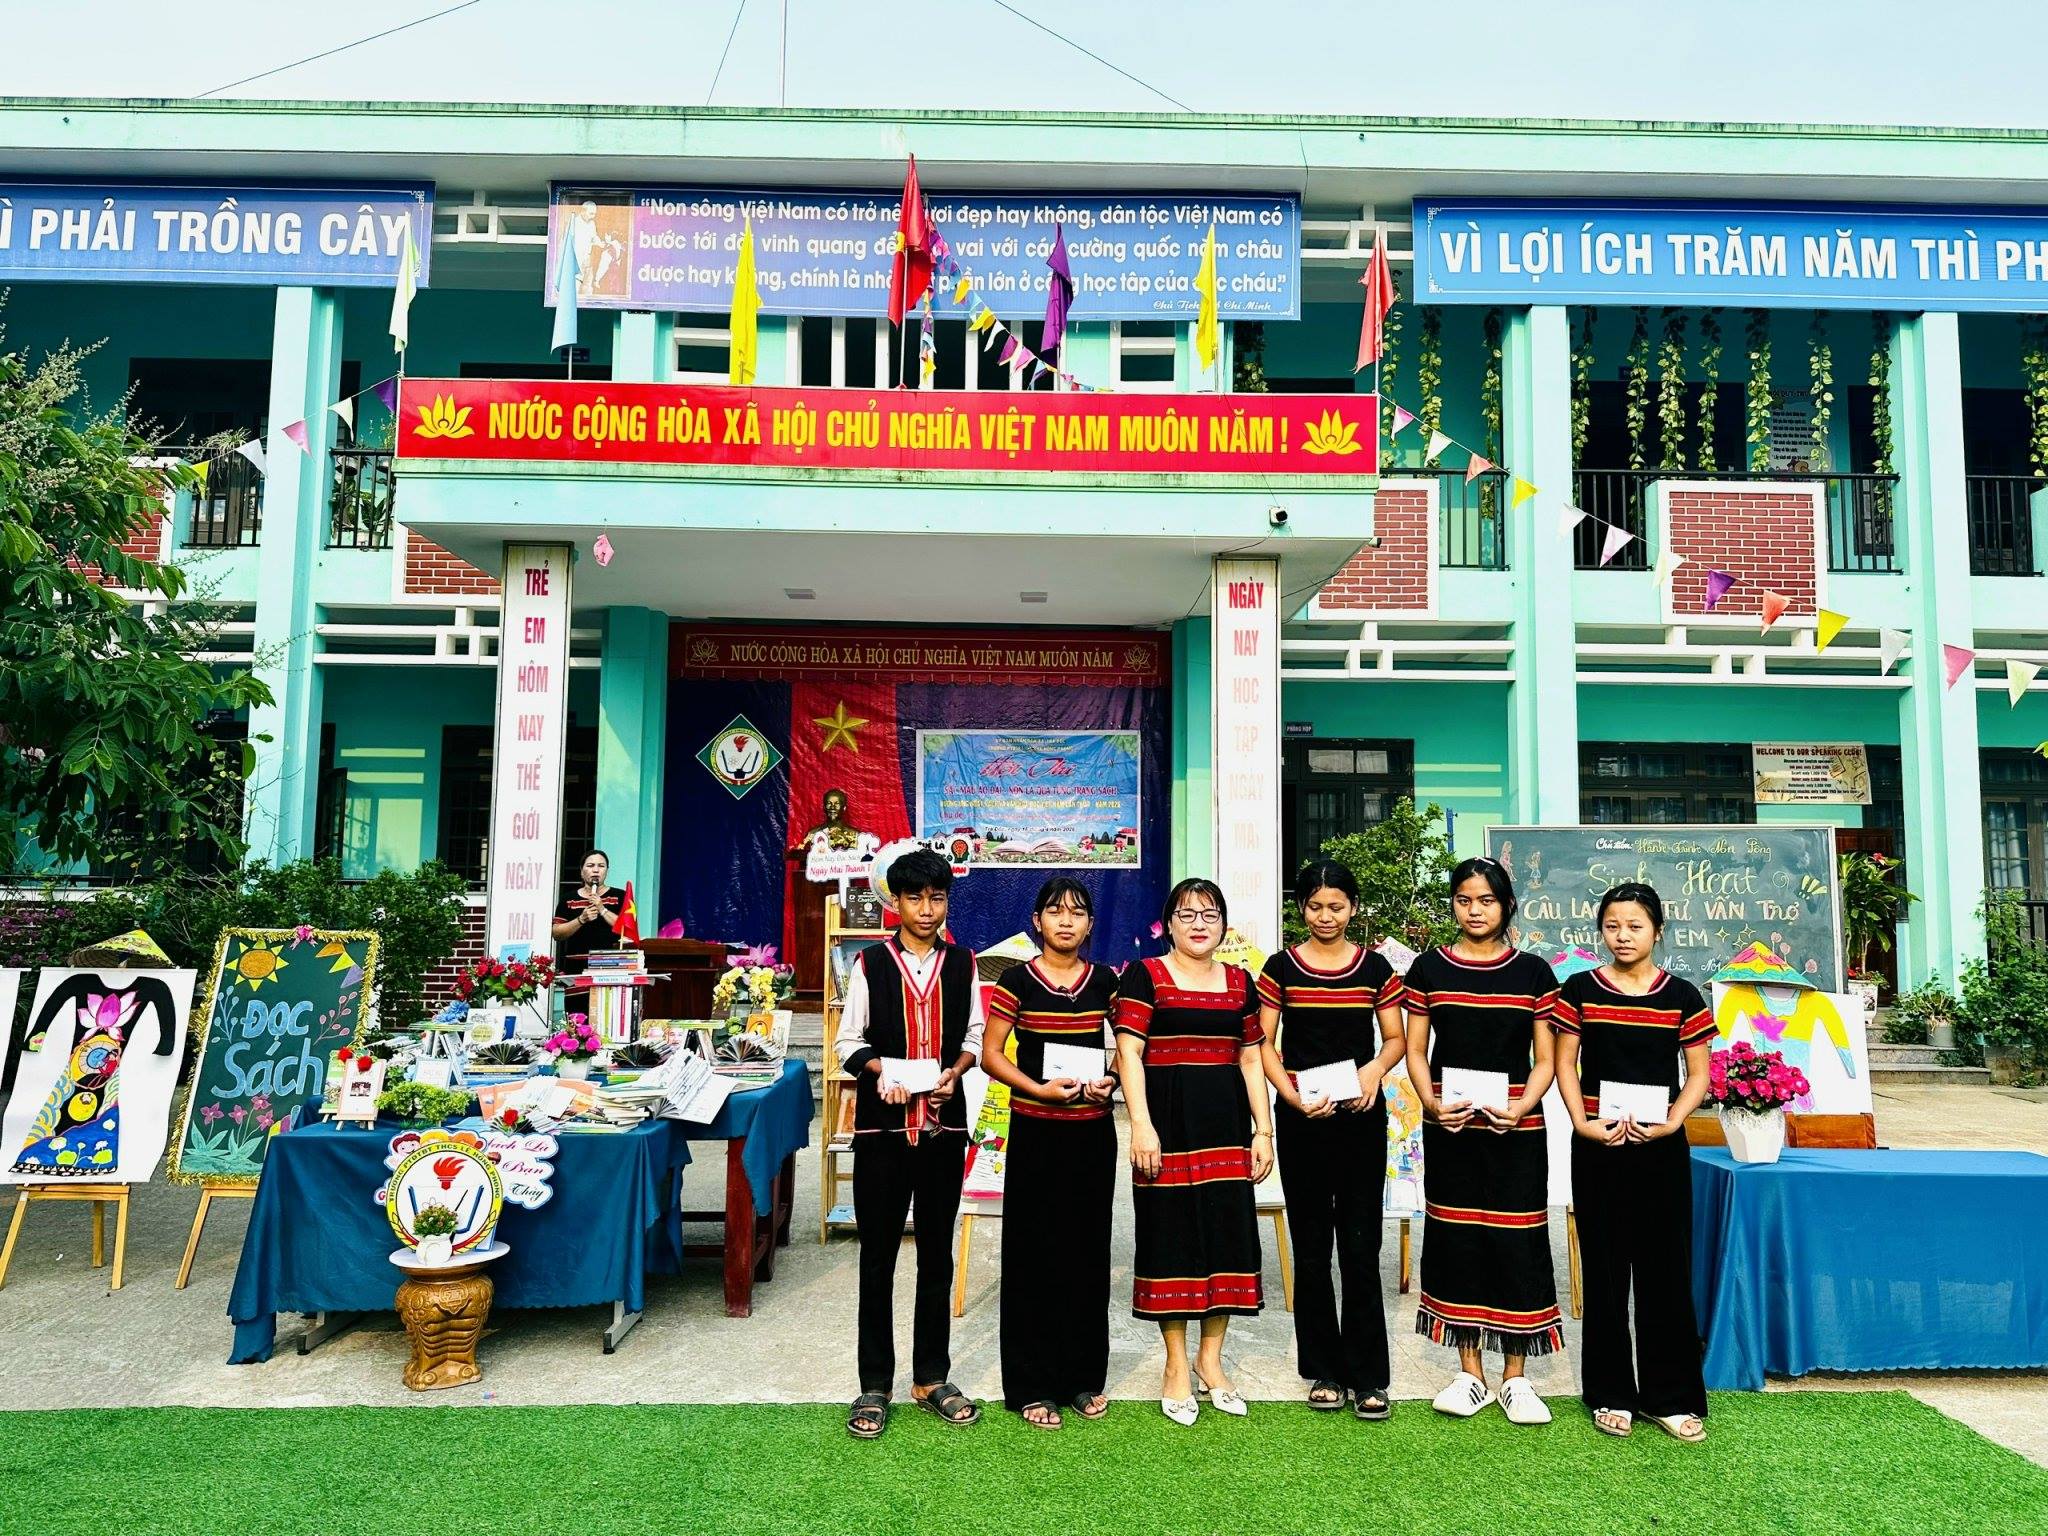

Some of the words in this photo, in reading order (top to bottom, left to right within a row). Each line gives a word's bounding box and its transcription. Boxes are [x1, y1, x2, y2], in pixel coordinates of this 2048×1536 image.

[29, 198, 135, 252] PHẢI
[153, 197, 302, 255] TRỒNG
[319, 204, 409, 257] CÂY
[691, 198, 735, 223] sông
[739, 200, 775, 224] Việt
[779, 201, 821, 221] Nam
[825, 202, 849, 222] có
[852, 200, 877, 222] trở
[880, 203, 901, 222] nê
[956, 205, 993, 229] đẹp
[996, 205, 1030, 229] hay
[1034, 204, 1096, 230] không,
[1100, 204, 1136, 224] dân
[1139, 204, 1170, 230] tộc
[1174, 204, 1209, 230] Việt
[1213, 206, 1255, 226] Nam
[1260, 205, 1283, 226] có
[639, 231, 687, 251] bước
[693, 230, 718, 251] tới
[762, 234, 800, 253] vinh
[806, 239, 867, 261] quang
[956, 238, 984, 257] vai
[991, 237, 1018, 257] với
[1067, 237, 1127, 263] cường
[1133, 234, 1181, 262] quốc
[1235, 239, 1283, 259] châu
[1440, 222, 1482, 274] VÌ
[1499, 226, 1563, 283] LỢI
[1580, 222, 1654, 275] ÍCH
[1667, 226, 1787, 278] TRĂM
[1804, 229, 1897, 280] NĂM
[1911, 229, 1981, 281] THÌ
[1995, 240, 2048, 282] PH
[638, 265, 686, 292] được
[688, 266, 722, 288] hay
[725, 266, 786, 292] kng,
[790, 265, 840, 289] chính
[843, 267, 861, 289] là
[988, 270, 1016, 291] lớn
[1019, 270, 1031, 291] ở
[1083, 272, 1117, 297] học
[1154, 269, 1189, 292] của
[488, 394, 562, 440] NƯỚC
[572, 396, 646, 449] CỘNG
[657, 398, 712, 444] HÒA
[723, 402, 762, 445] XÃ
[773, 401, 819, 454] HỘI
[827, 400, 880, 448] CHỦ
[888, 407, 972, 450] NGHĨA
[979, 406, 1036, 459] VIỆT
[1045, 414, 1109, 453] NAM
[1119, 408, 1199, 453] MUÔN
[1210, 408, 1274, 455] NĂM
[525, 560, 549, 596] TRẺ
[1228, 576, 1264, 609] NGÀY
[524, 617, 546, 644] EM
[1233, 630, 1259, 656] NAY
[730, 639, 768, 662] NƯỚC
[770, 640, 807, 667] CỘNG
[810, 641, 838, 664] HÒA
[843, 643, 862, 664] XÃ
[866, 642, 890, 669] HỘI
[893, 640, 920, 665] CHỦ
[924, 644, 967, 665] NGHĨA
[971, 643, 1002, 670] VIỆT
[1005, 650, 1036, 667] NAM
[1039, 645, 1079, 668] MUÔN
[1082, 647, 1114, 668] NĂM
[517, 659, 549, 693] HÔM
[518, 714, 545, 741] NAY
[1756, 747, 1785, 756] WELCOME
[1786, 748, 1795, 756] TO
[1797, 748, 1809, 756] OUR
[1811, 748, 1842, 756] SPEAKING
[516, 754, 543, 791] THẾ
[512, 806, 541, 840] GIỚI
[505, 856, 543, 890] NGÀY
[507, 912, 535, 940] MAI
[1674, 927, 1709, 948] EM
[211, 1037, 324, 1098] Sách
[490, 1171, 501, 1199] PHONG
